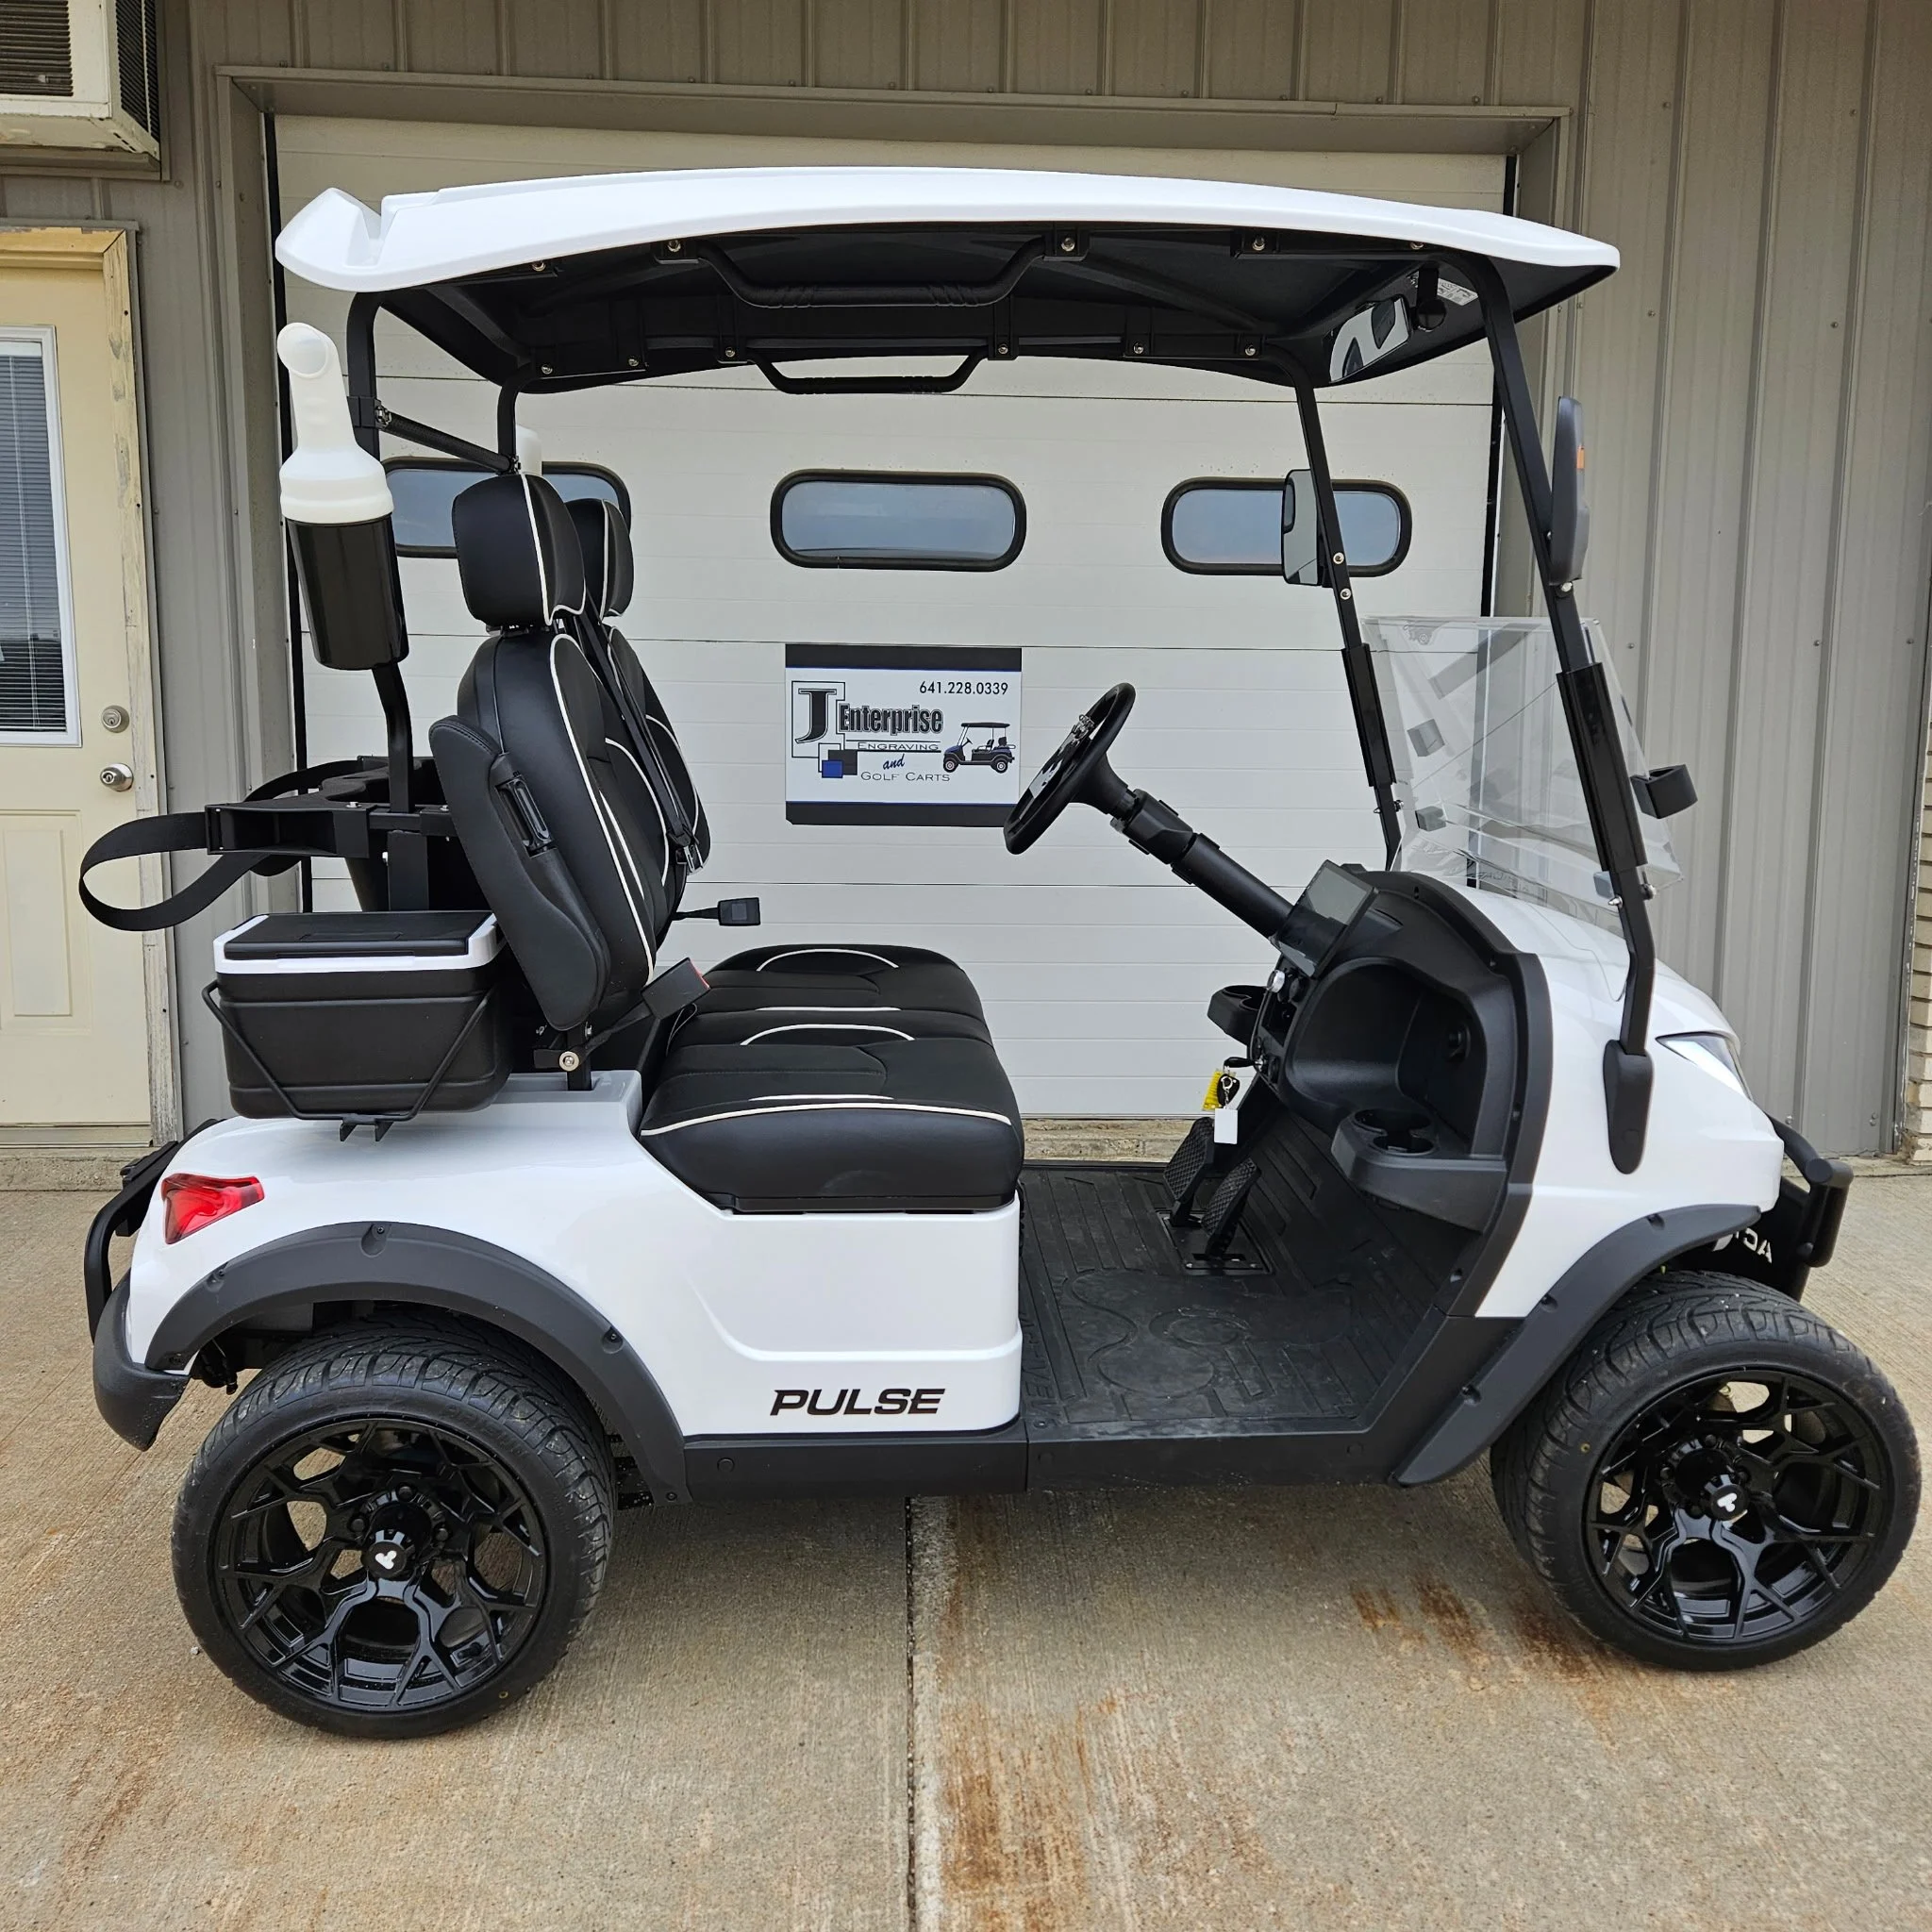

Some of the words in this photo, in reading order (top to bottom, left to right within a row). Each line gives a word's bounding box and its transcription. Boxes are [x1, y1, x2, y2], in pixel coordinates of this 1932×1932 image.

[919, 681, 1008, 695] 641.228.0339
[794, 688, 838, 744] J
[838, 702, 943, 736] Enterprise
[857, 741, 939, 751] ENGRAVING
[882, 754, 906, 771] and
[860, 771, 900, 781] GOLF
[905, 772, 951, 782] CARTS
[769, 1388, 946, 1416] PULSE
